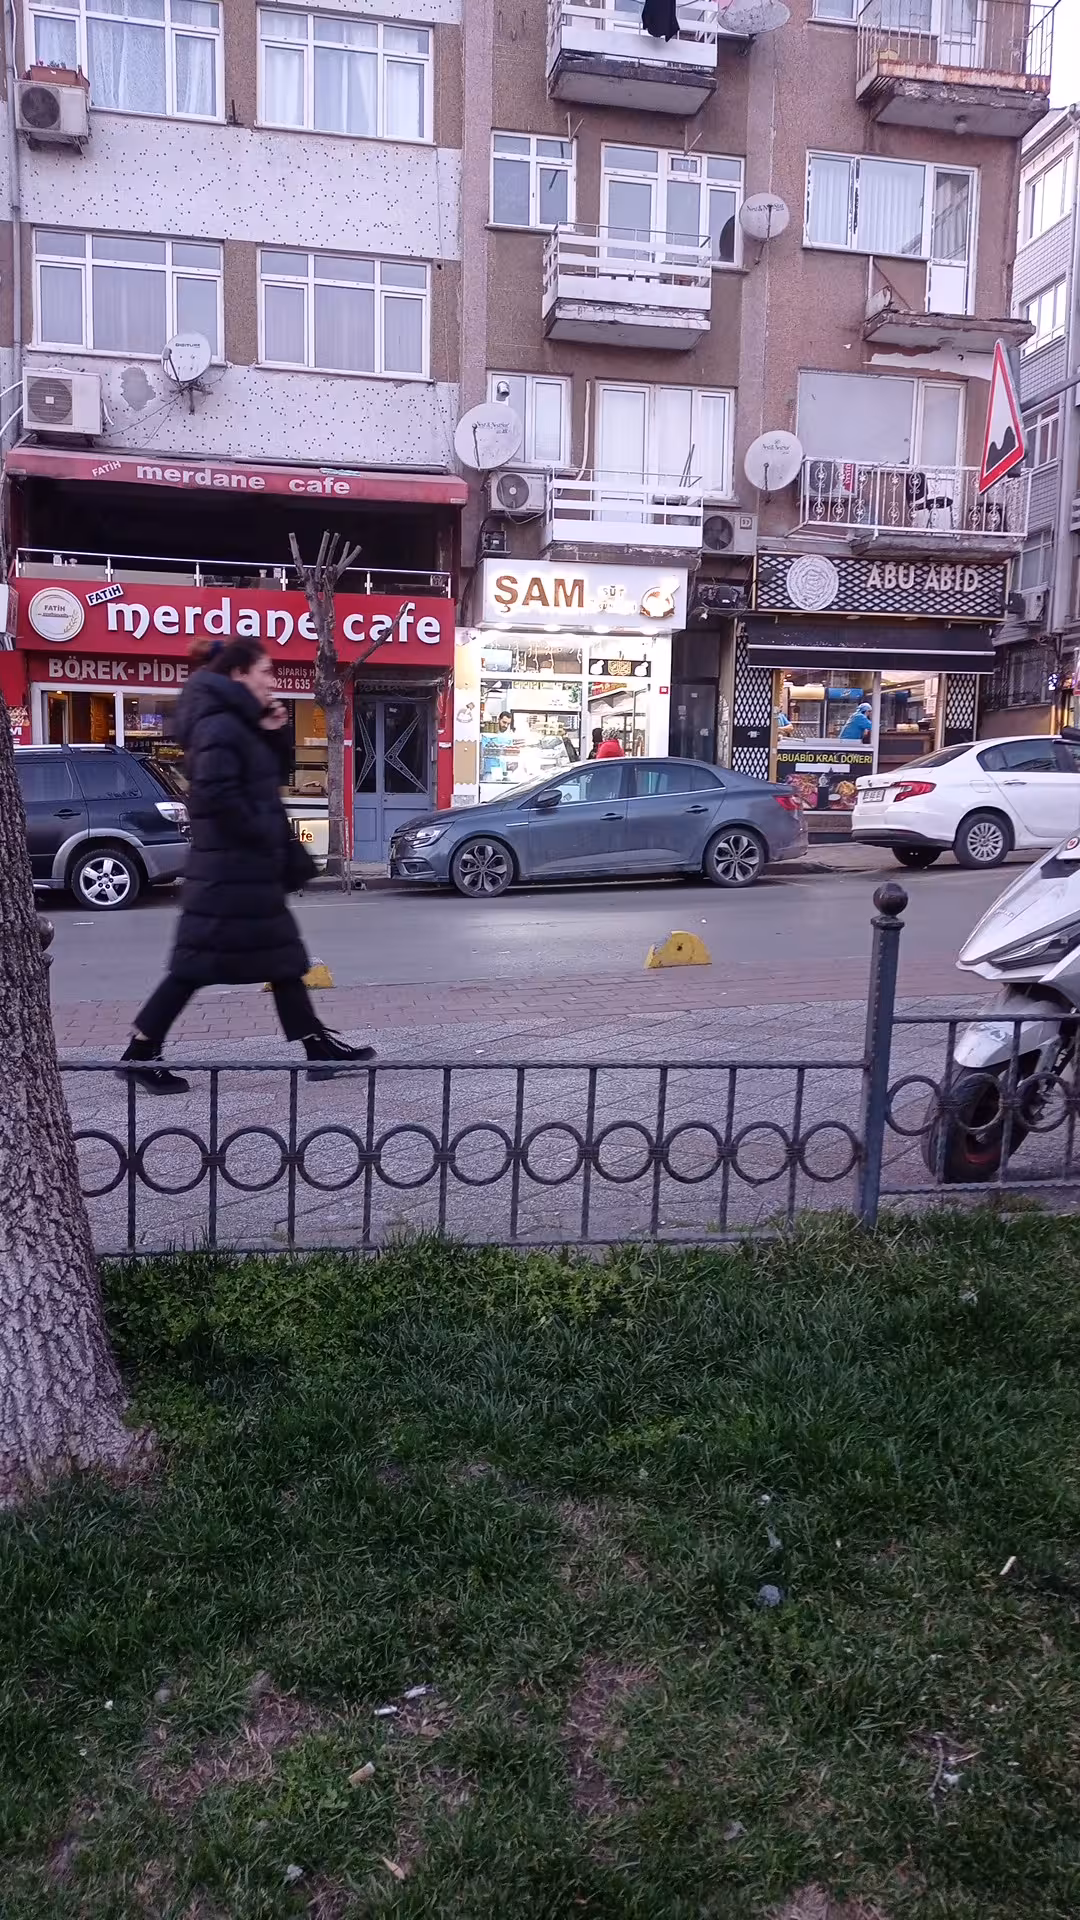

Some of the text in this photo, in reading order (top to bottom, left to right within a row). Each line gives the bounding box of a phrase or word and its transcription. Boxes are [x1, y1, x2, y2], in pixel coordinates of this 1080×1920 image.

[136, 464, 351, 495] merdane cafe
[867, 563, 915, 589] ABU
[87, 585, 122, 604] FATİH
[494, 575, 585, 613] ŞAM
[108, 597, 441, 646] merdane cafe
[277, 666, 308, 678] SİPARİŞ
[294, 678, 311, 690] 635
[816, 753, 839, 762] KRAL
